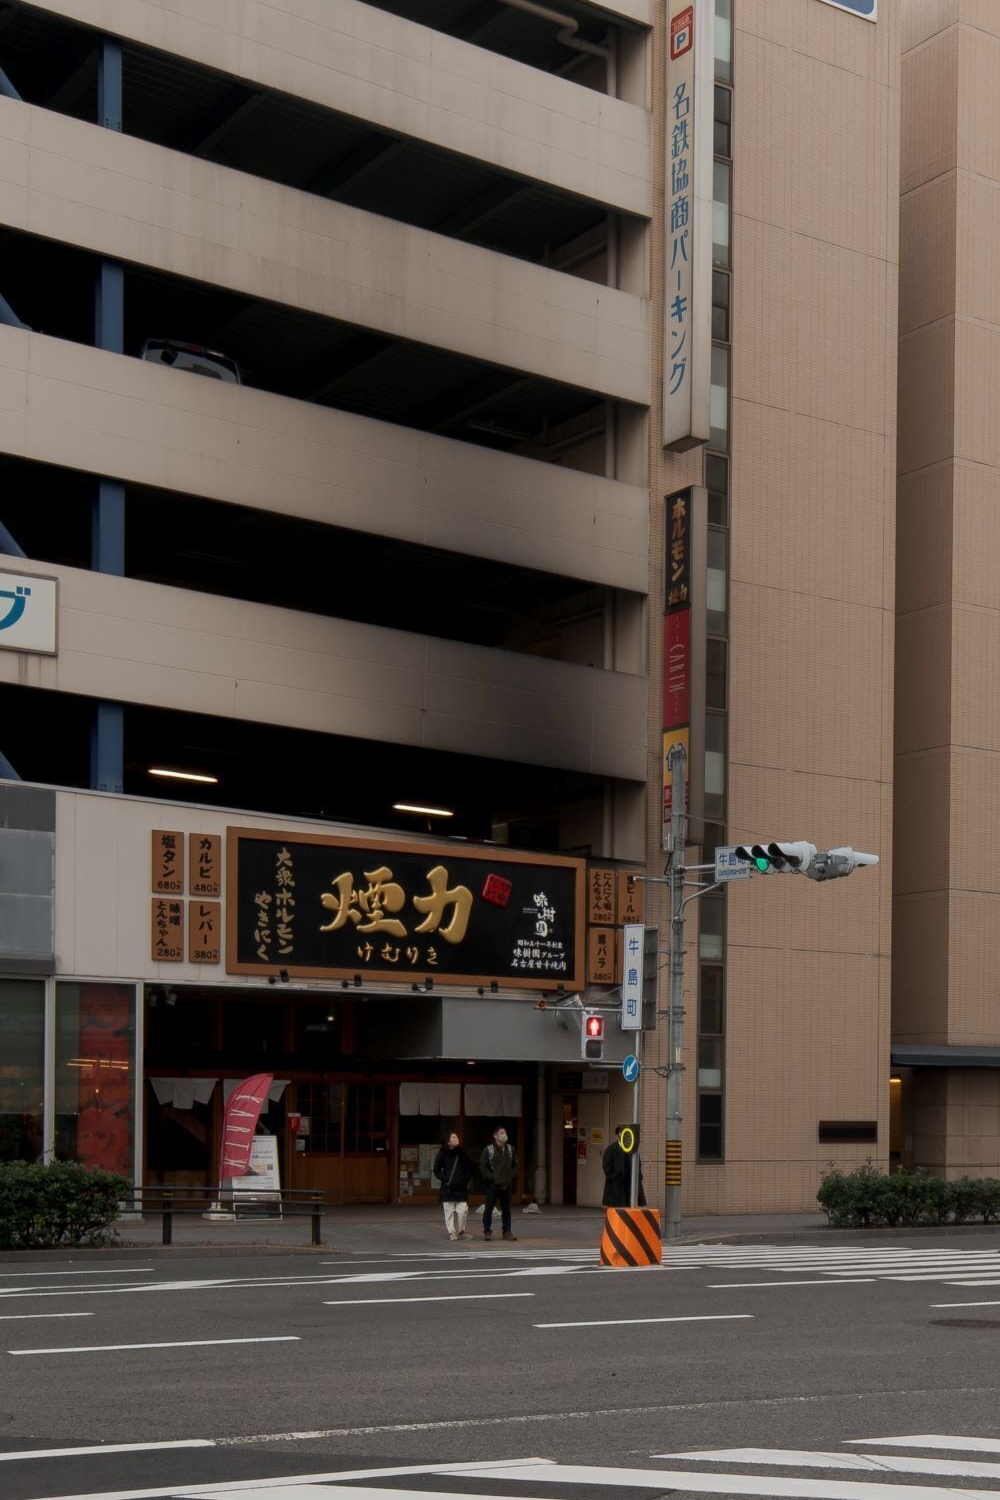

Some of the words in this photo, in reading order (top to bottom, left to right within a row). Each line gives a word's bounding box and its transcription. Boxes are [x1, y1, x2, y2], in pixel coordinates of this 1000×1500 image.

[676, 32, 687, 50] P
[670, 81, 690, 395] 名鉄協商パーキング
[161, 834, 177, 878] 塩タン
[199, 838, 213, 879] カルビ
[275, 847, 296, 954] 大衆ホルモン
[320, 865, 473, 945] 煙力
[156, 901, 169, 947] とんちゃん
[198, 905, 213, 944] レバー
[254, 890, 272, 961] やきにく
[357, 941, 438, 966] けむりき
[626, 937, 639, 1017] 牛島町
